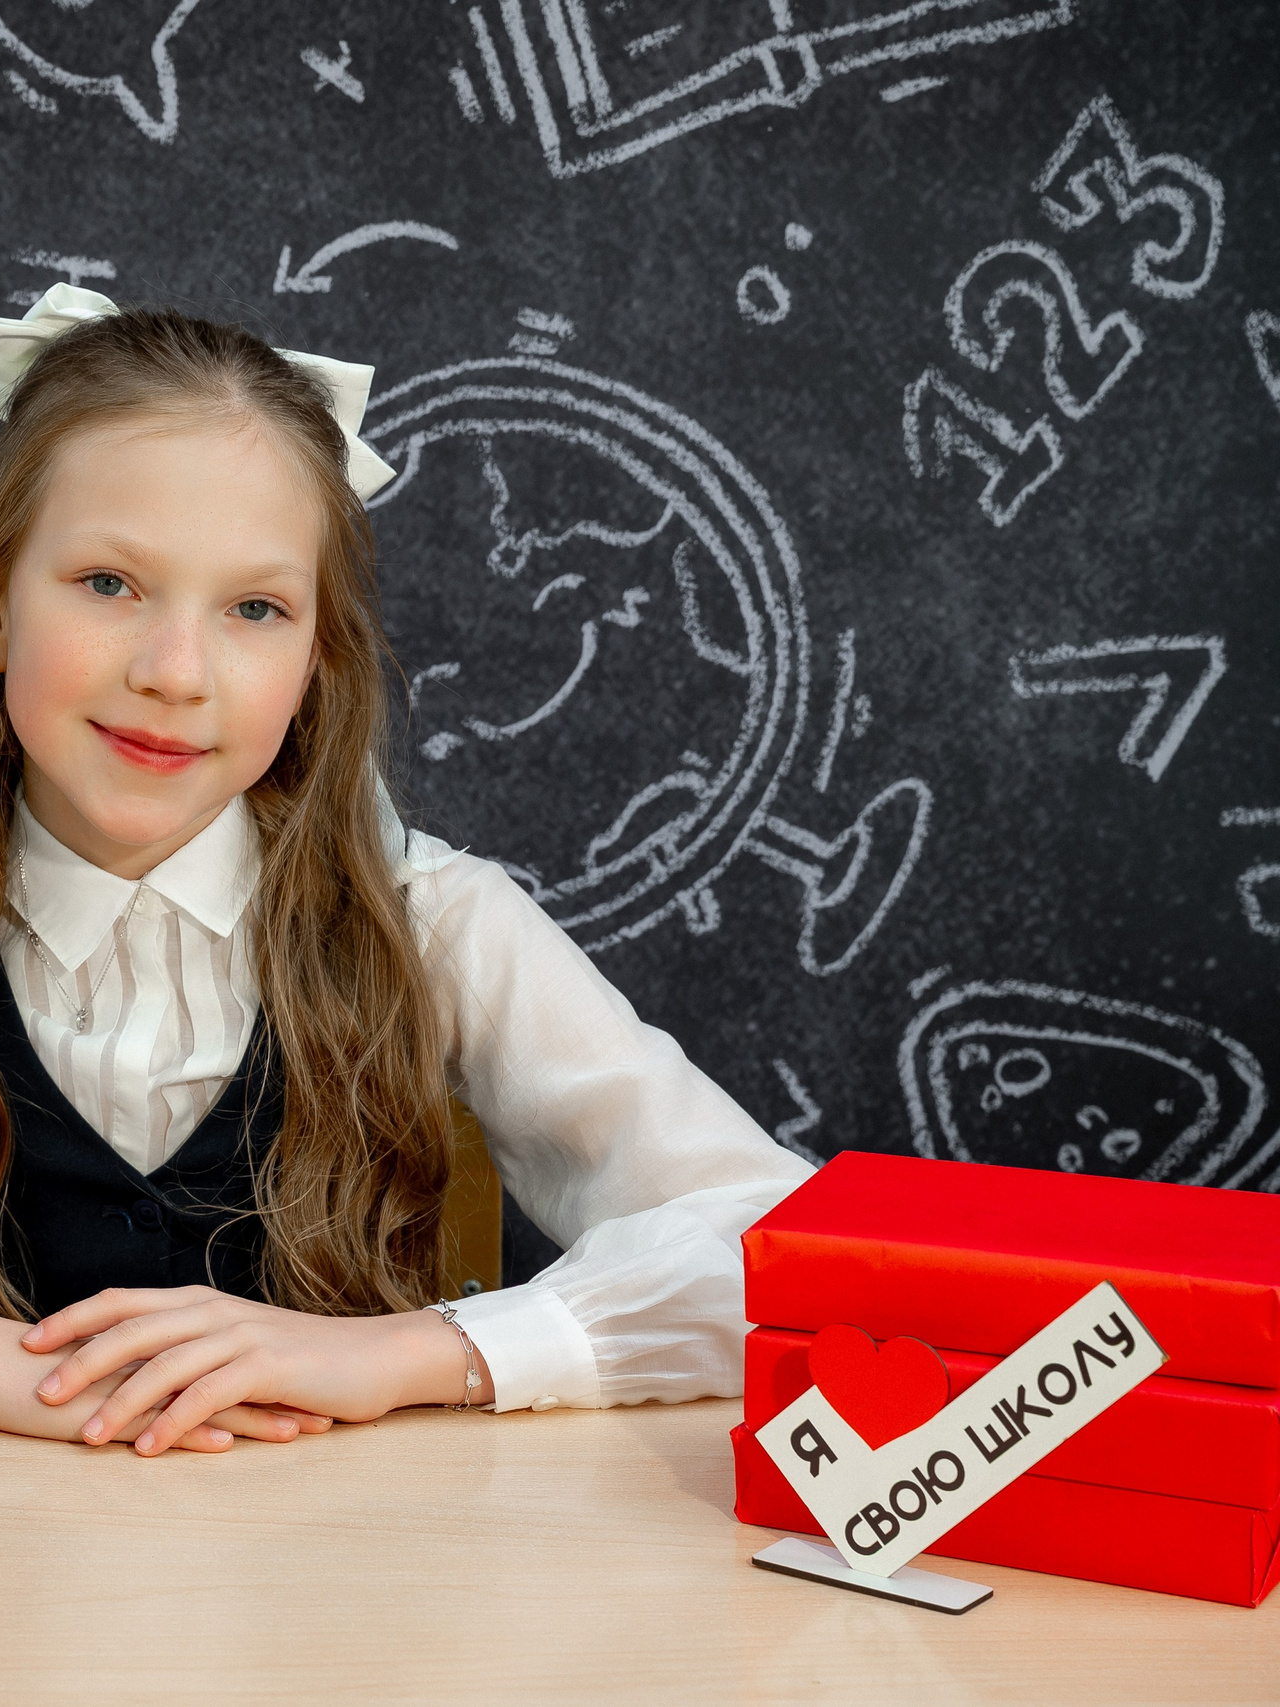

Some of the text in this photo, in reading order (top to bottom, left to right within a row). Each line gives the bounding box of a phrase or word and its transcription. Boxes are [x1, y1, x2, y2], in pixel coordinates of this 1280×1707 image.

[789, 1418, 838, 1478] Я
[844, 1311, 1136, 1557] СВОЮ ШКОЛУ
